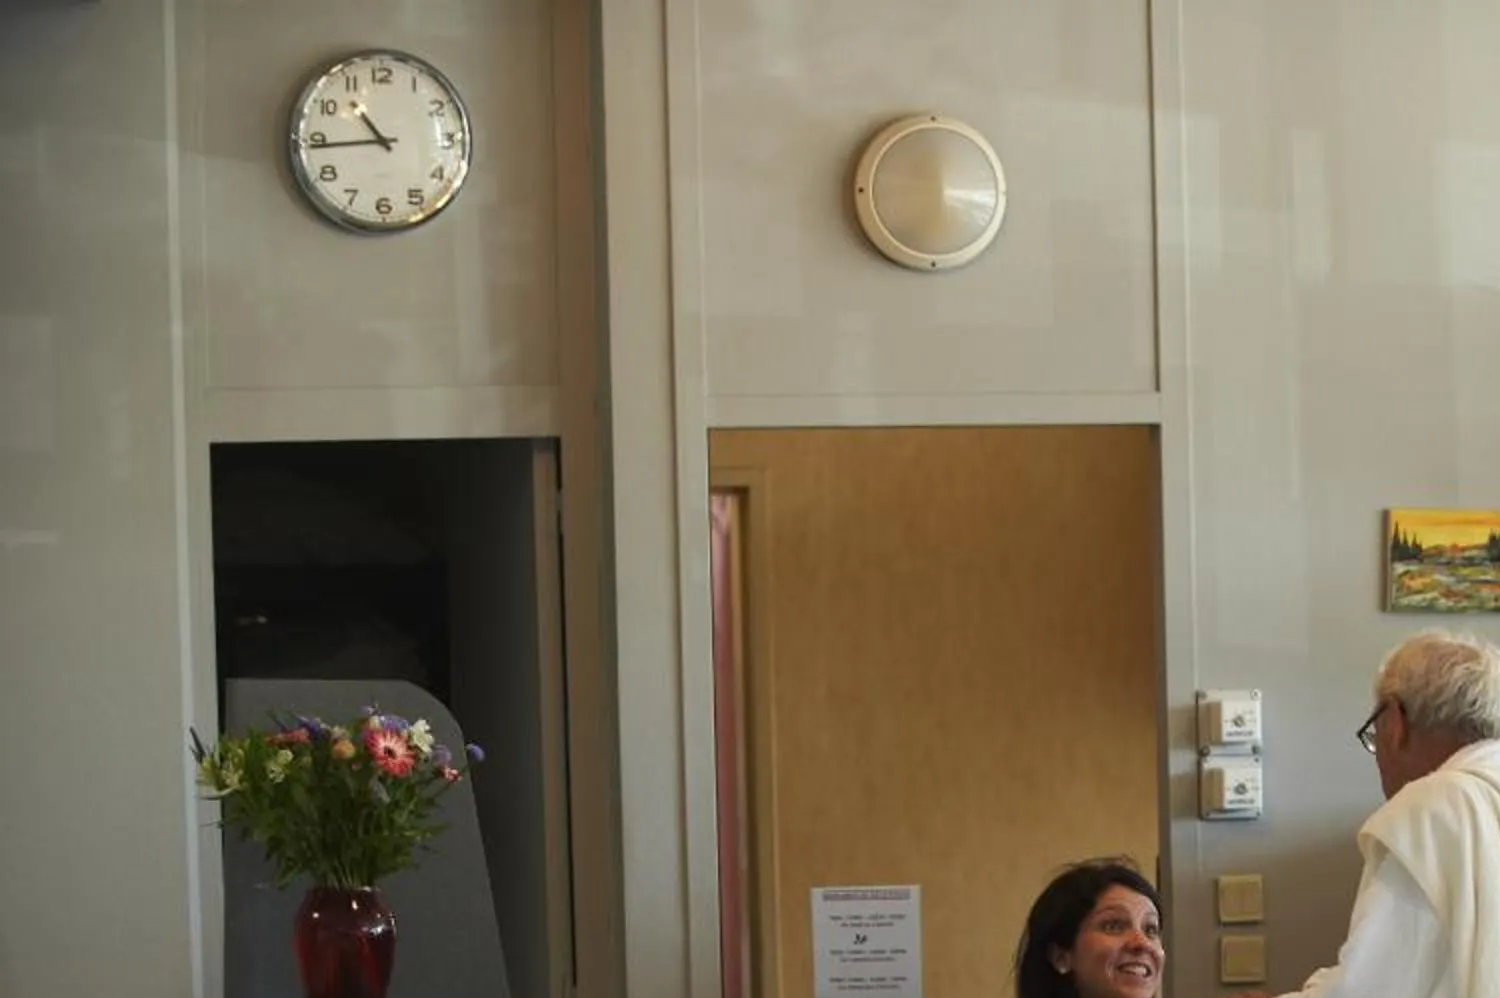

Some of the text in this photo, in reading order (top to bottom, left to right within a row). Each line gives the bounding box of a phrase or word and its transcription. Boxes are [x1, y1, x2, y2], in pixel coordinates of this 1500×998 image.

[345, 75, 358, 92] 11
[371, 67, 393, 83] 12
[411, 75, 417, 92] 1
[320, 99, 337, 116] 10
[428, 100, 445, 117] 2
[309, 132, 327, 148] 9
[441, 133, 455, 149] 3
[319, 165, 337, 182] 8
[430, 166, 444, 182] 4
[344, 189, 359, 206] 7
[408, 189, 424, 206] 5
[375, 198, 393, 215] 6
